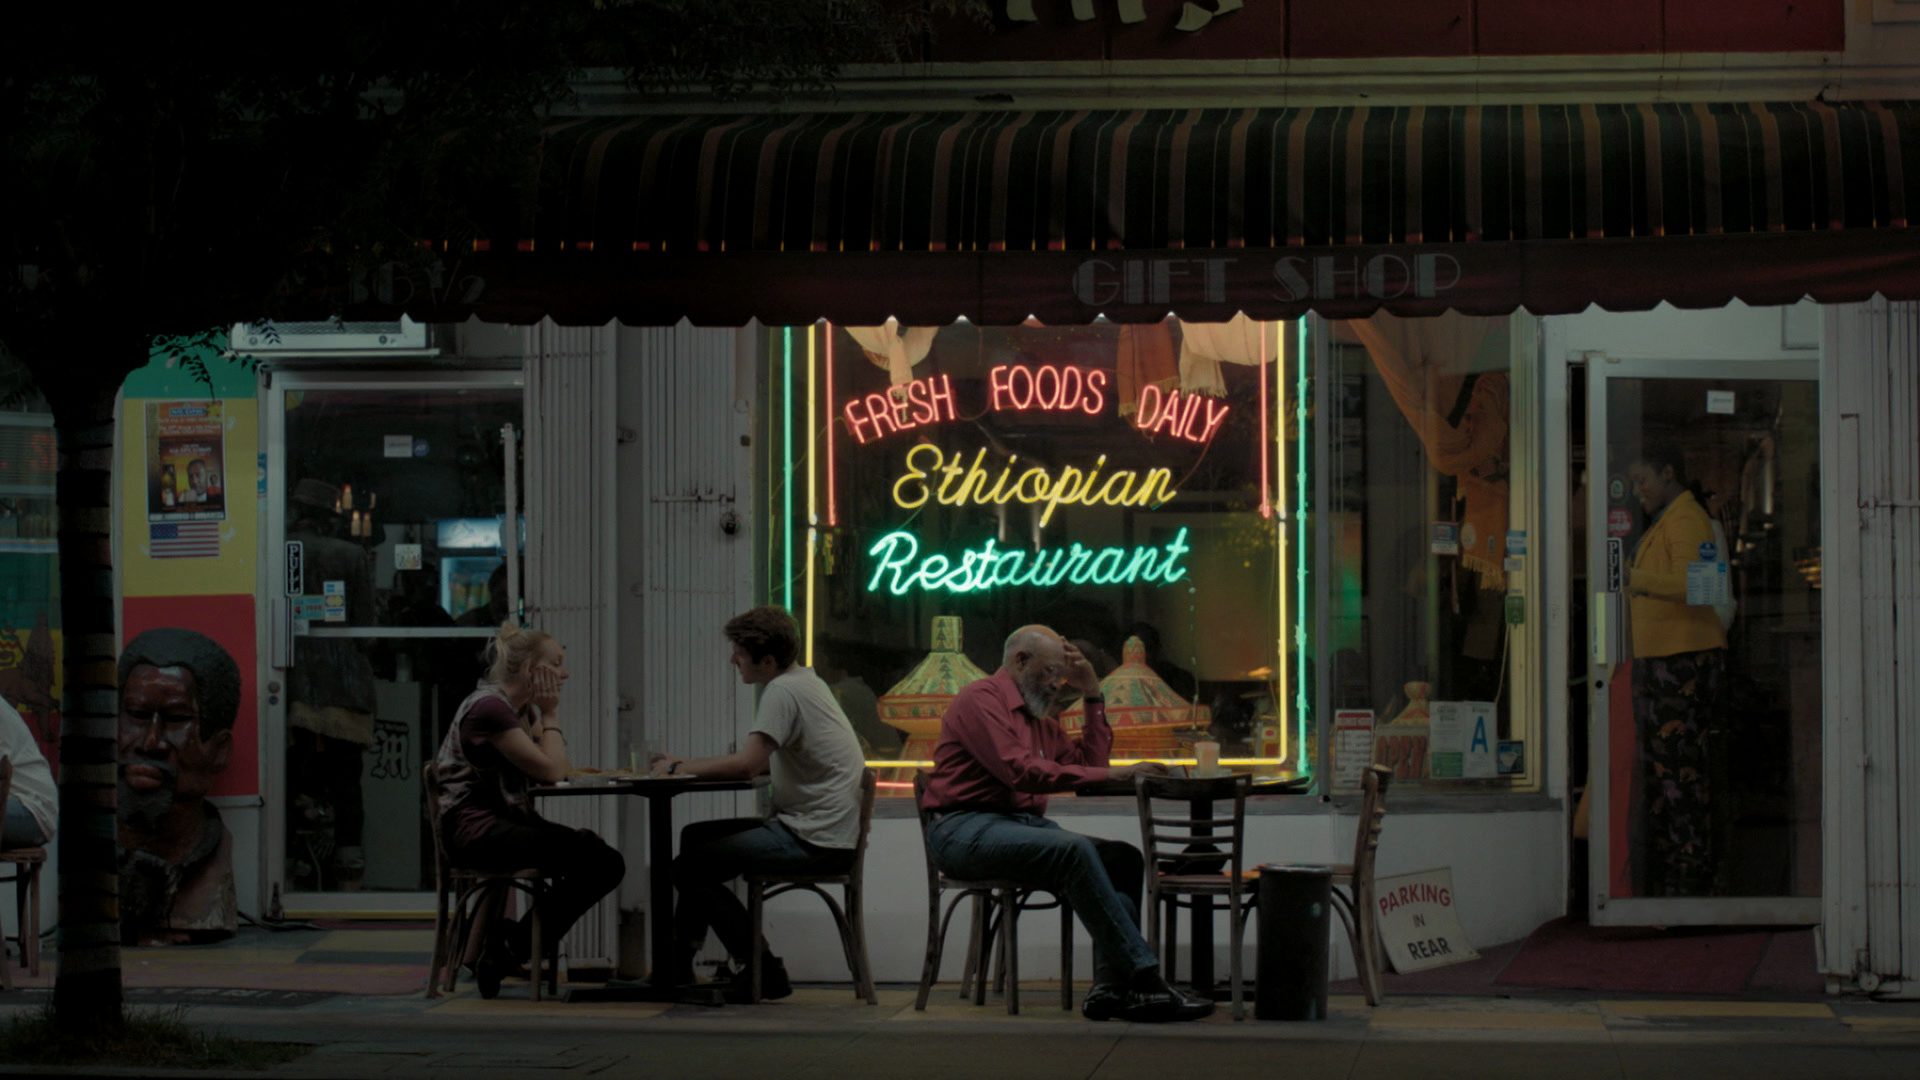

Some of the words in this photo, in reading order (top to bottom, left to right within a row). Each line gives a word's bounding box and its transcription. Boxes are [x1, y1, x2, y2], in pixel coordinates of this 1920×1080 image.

[1072, 258, 1238, 306] GIFT
[1272, 253, 1462, 302] SHOP
[844, 374, 955, 444] FRESH
[990, 364, 1107, 415] FOODS
[1137, 384, 1229, 443] DAILY
[892, 443, 1177, 529] Ethiopian
[289, 545, 299, 593] PULL
[868, 526, 1190, 596] Restaurant
[1608, 541, 1619, 592] PULL
[1471, 715, 1488, 753] A
[1379, 883, 1451, 917] PARKING
[1413, 914, 1426, 928] IN
[1407, 937, 1452, 960] REAR
